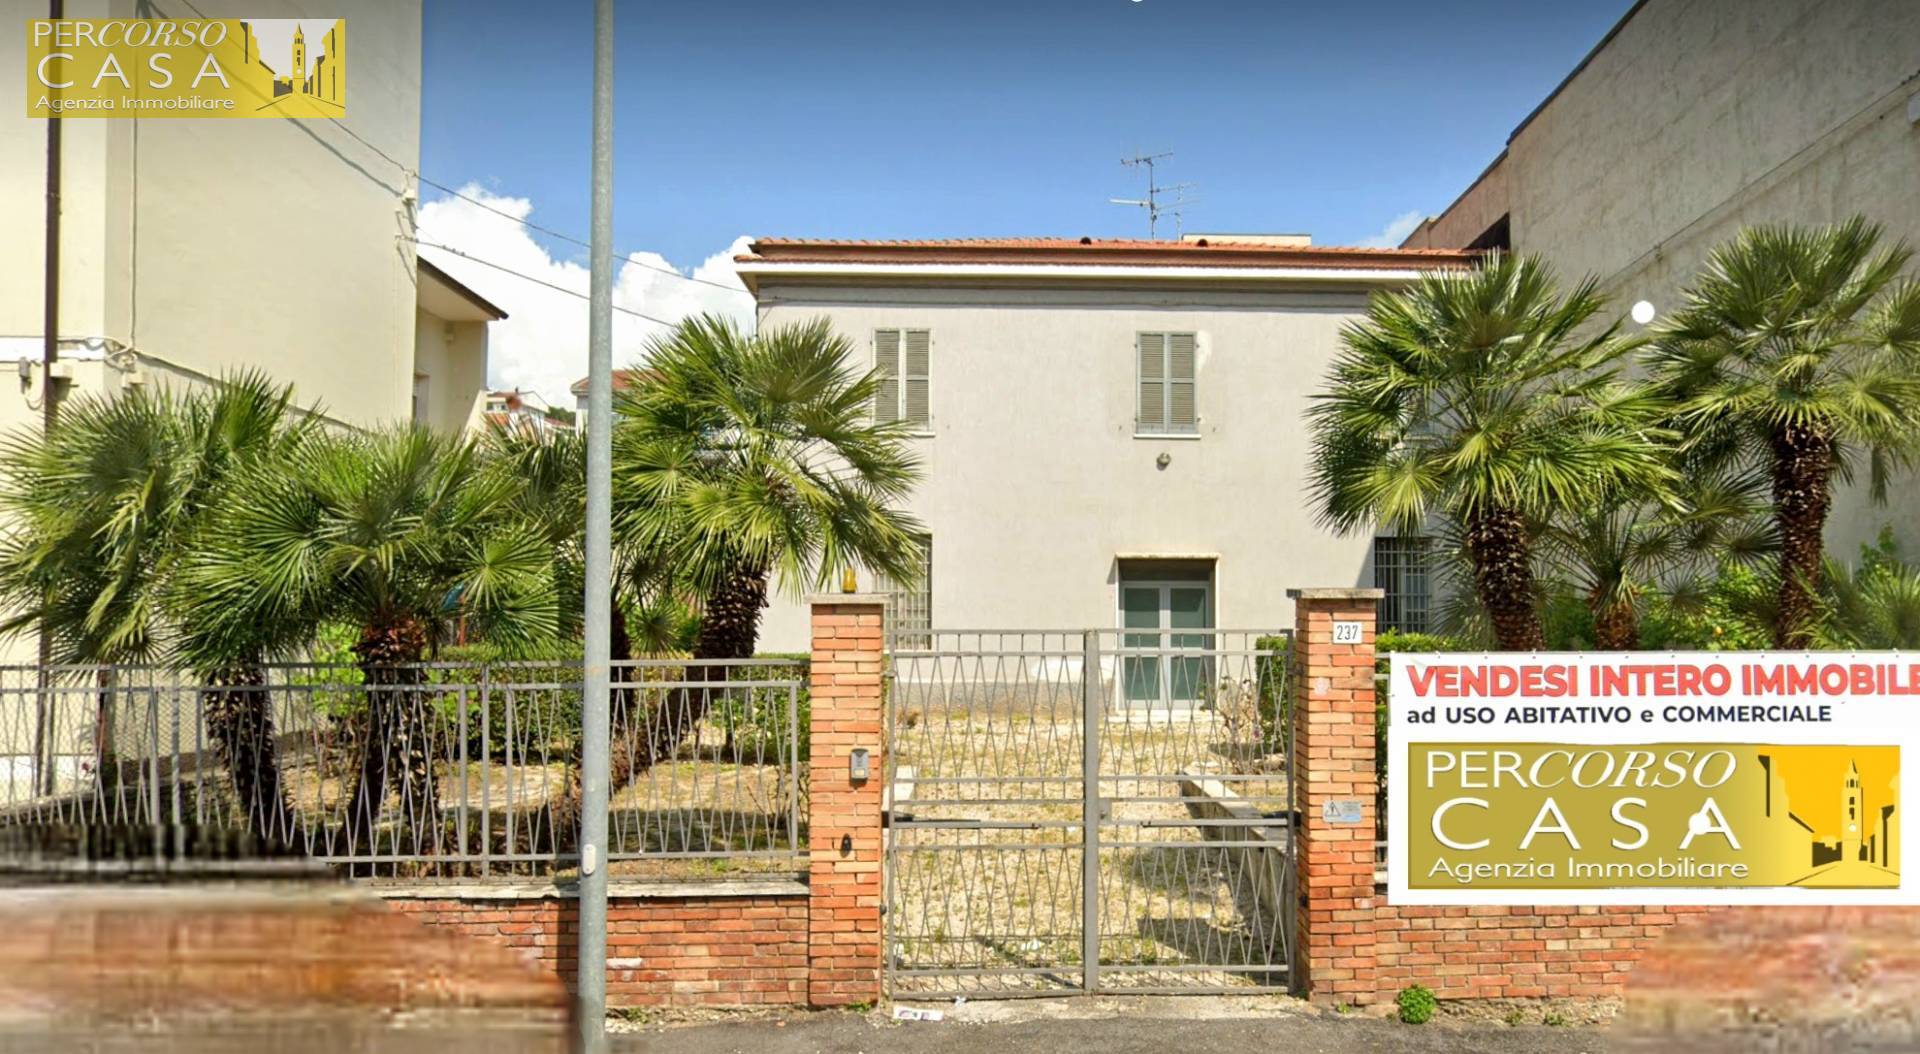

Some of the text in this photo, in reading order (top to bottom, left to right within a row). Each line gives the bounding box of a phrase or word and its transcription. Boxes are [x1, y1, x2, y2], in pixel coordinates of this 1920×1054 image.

[1336, 624, 1359, 640] 237
[1406, 665, 1577, 697] VENDESI
[1590, 664, 1730, 696] INTERO
[1407, 705, 1832, 724] ad USO ABITATIVO e COMMERCIALE
[1427, 751, 1737, 788] PERCORSO
[1431, 797, 1741, 850] CASA
[1428, 857, 1748, 883] Agenzia Immobiliare
